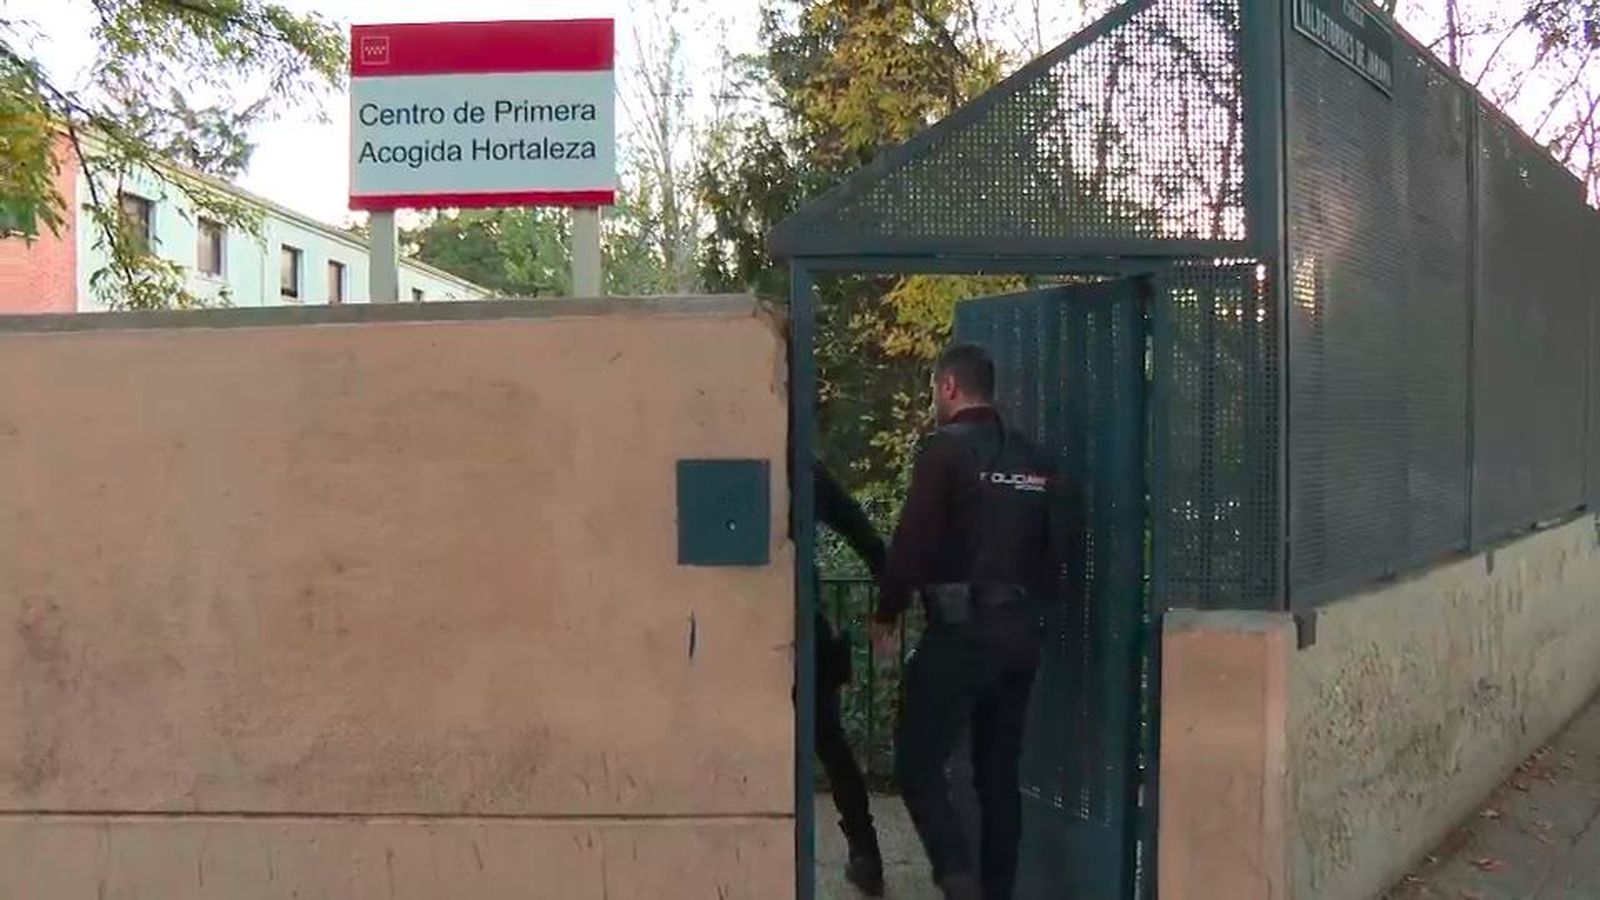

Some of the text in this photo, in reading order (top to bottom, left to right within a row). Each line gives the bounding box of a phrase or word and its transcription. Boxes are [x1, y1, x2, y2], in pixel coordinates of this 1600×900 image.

[359, 100, 596, 126] Centro de Primera
[358, 137, 596, 168] Acogida Hortaleza
